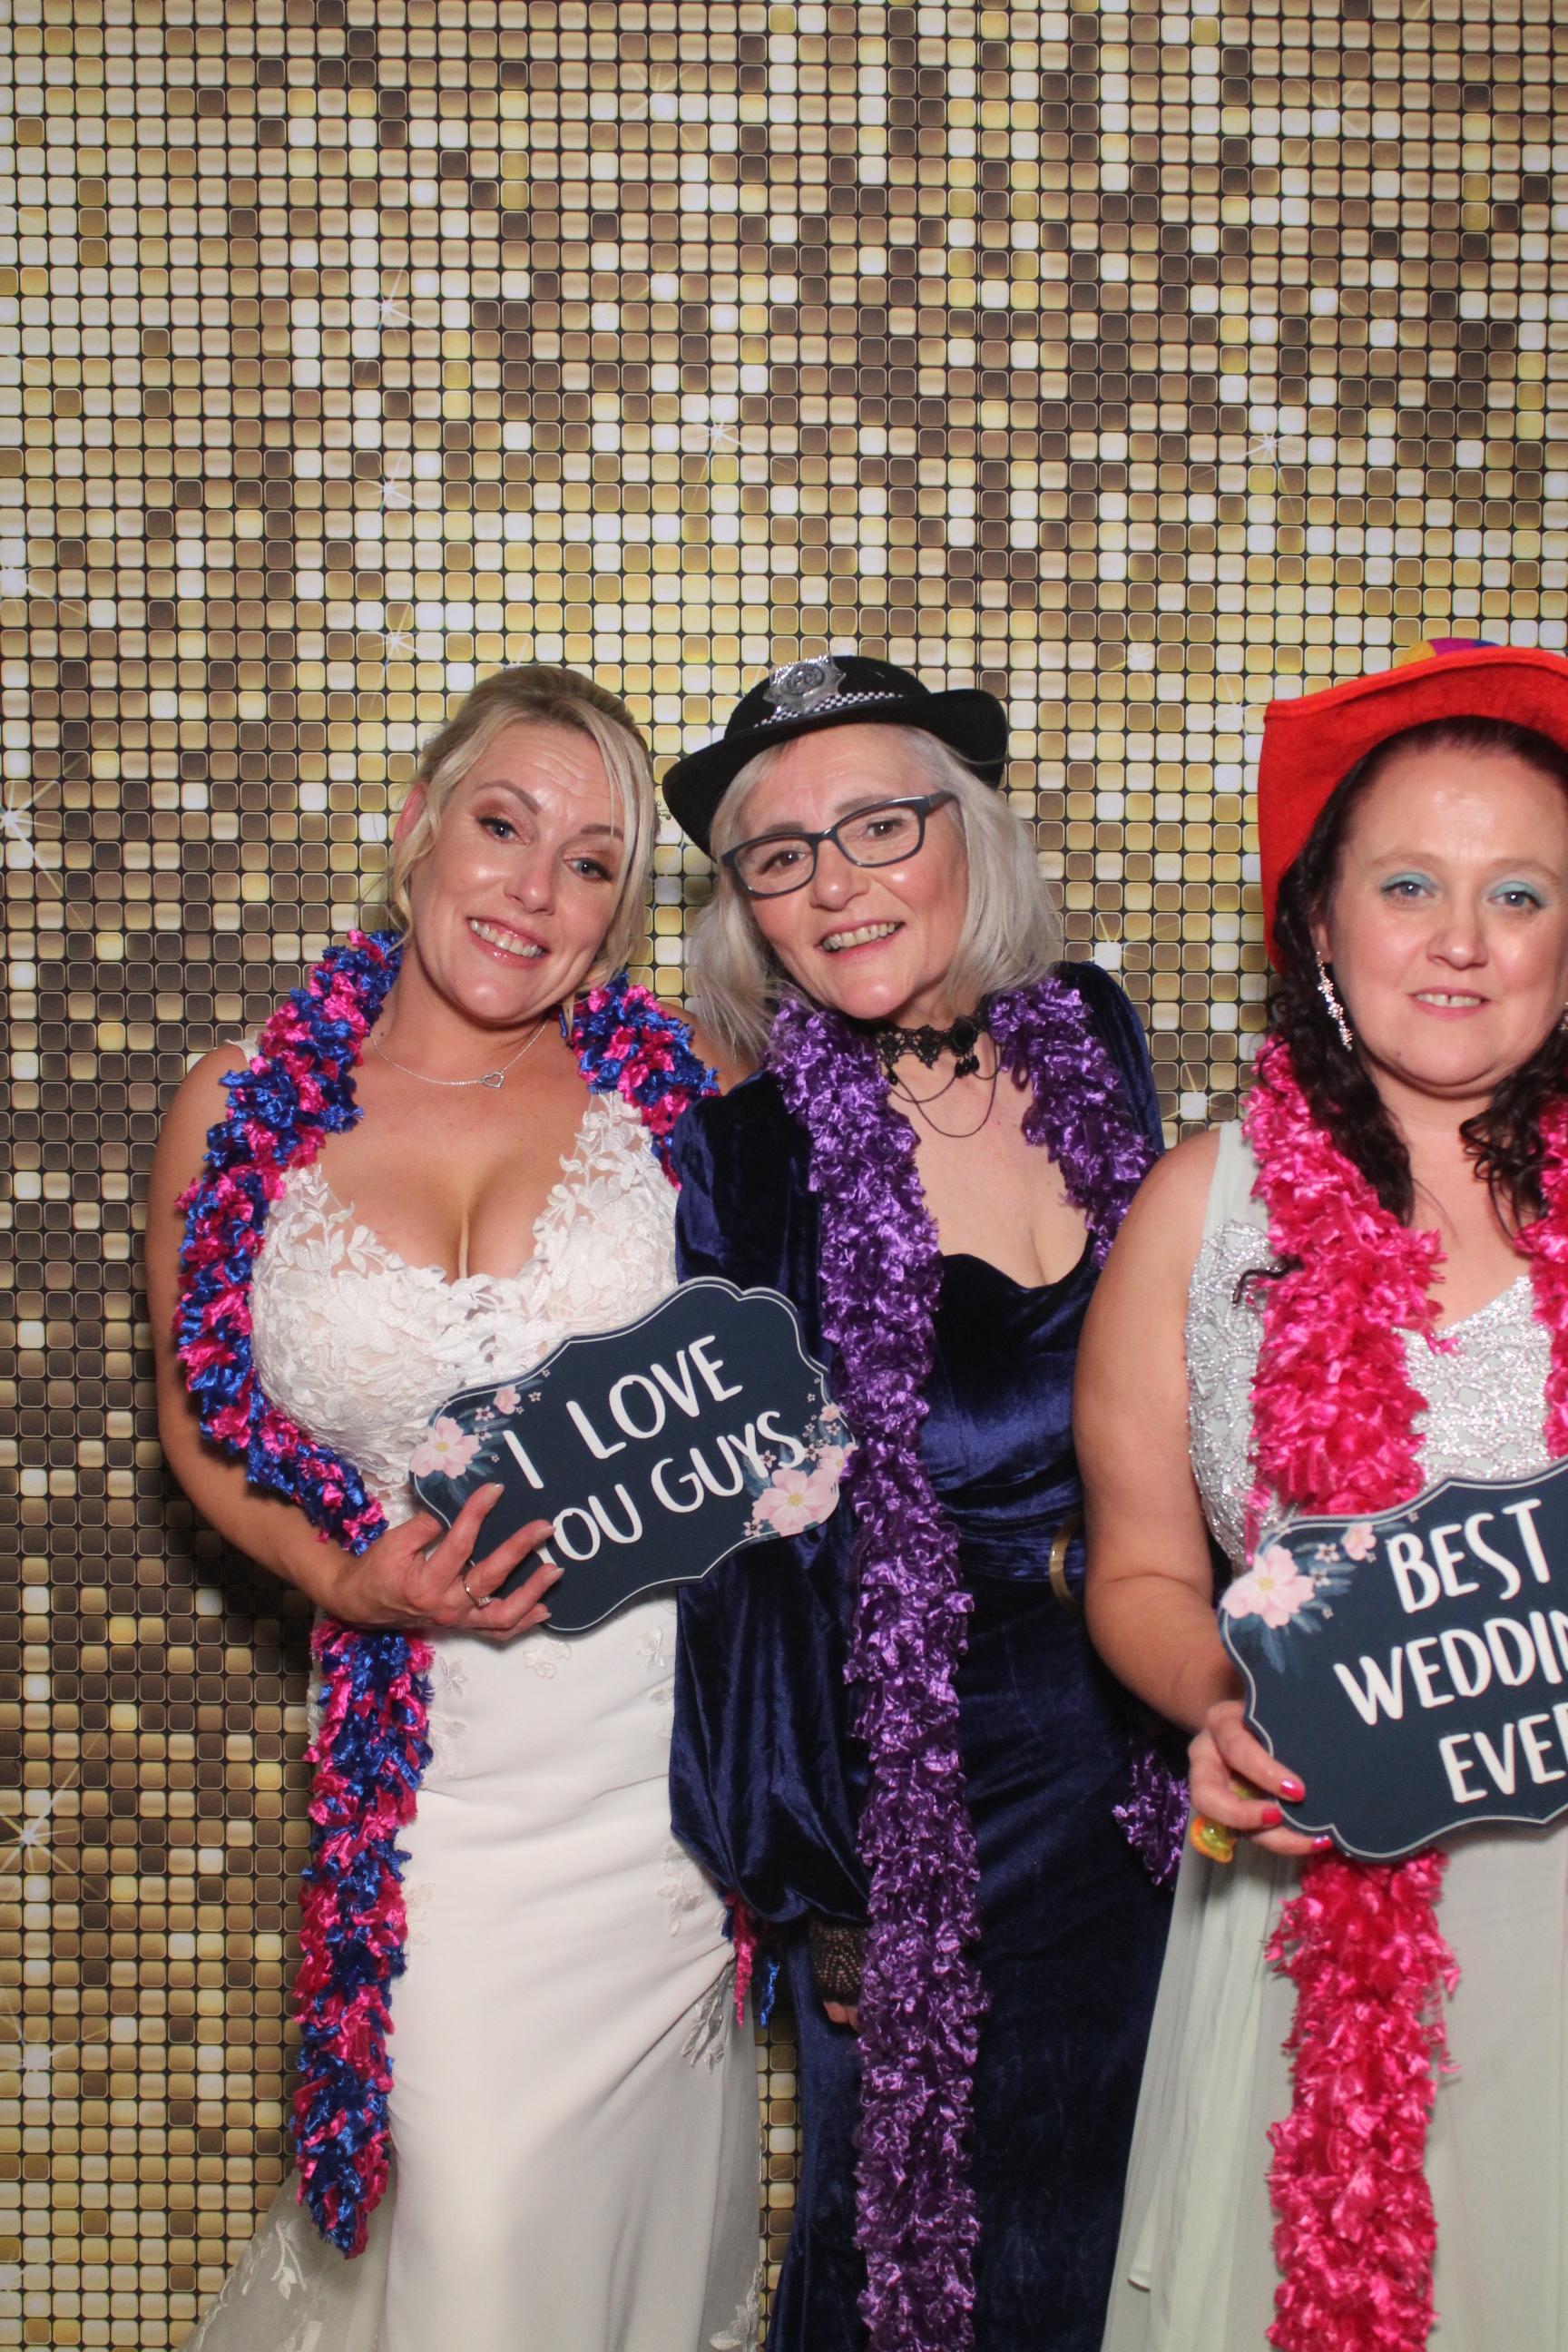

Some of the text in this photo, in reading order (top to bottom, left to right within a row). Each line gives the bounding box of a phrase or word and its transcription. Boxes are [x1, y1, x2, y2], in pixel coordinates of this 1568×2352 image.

[503, 1335, 743, 1489] I LOVE
[536, 1410, 807, 1565] OU GUYS
[1386, 1498, 1551, 1614] BEST
